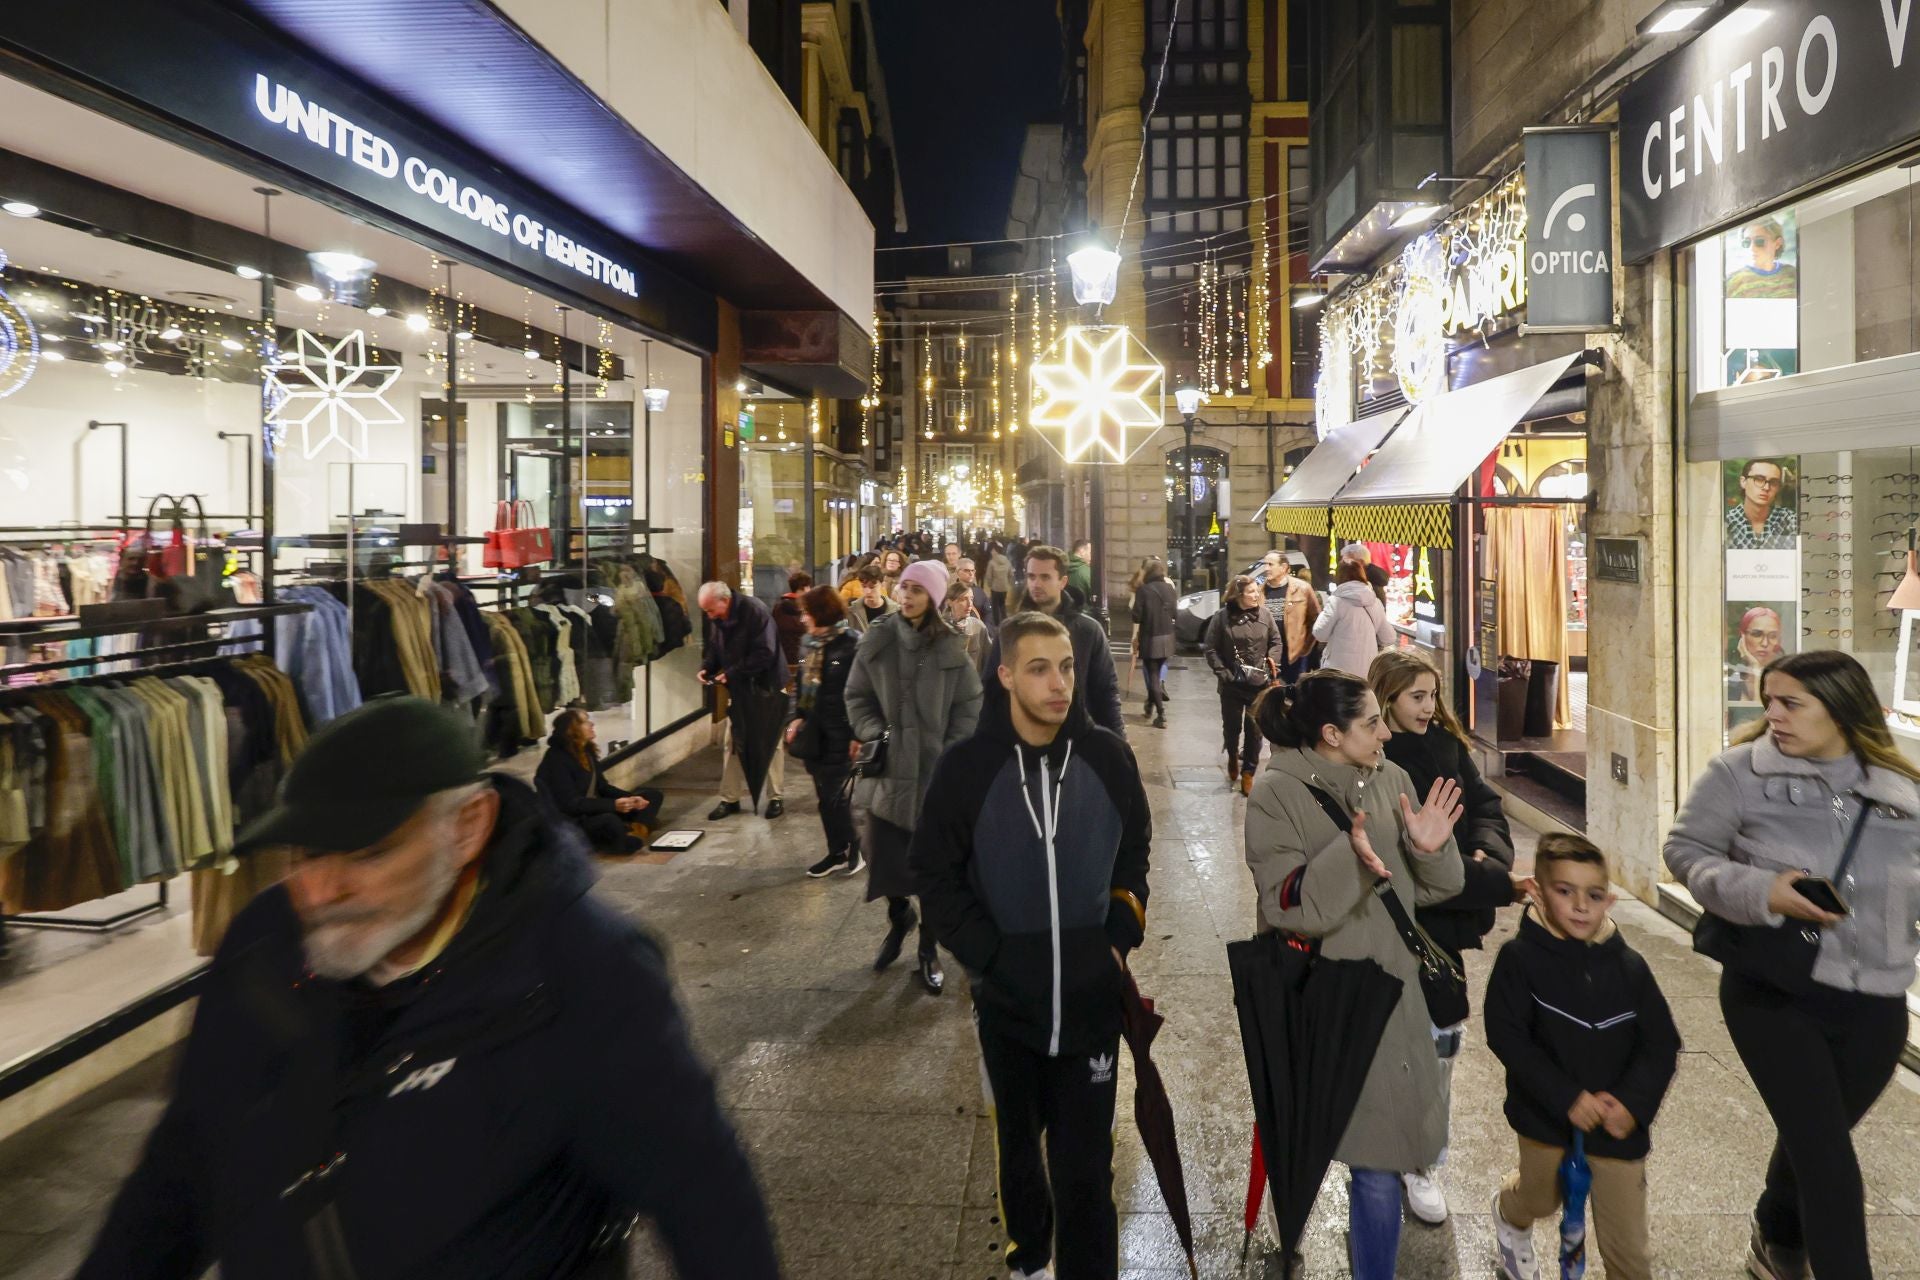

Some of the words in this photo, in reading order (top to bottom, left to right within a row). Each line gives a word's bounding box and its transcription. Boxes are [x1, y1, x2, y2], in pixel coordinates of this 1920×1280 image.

[255, 73, 399, 179] UNITED
[403, 157, 511, 236] COLORS
[512, 213, 544, 250] OF
[1642, 15, 1838, 200] CENTRO
[1531, 250, 1609, 275] OPTICA
